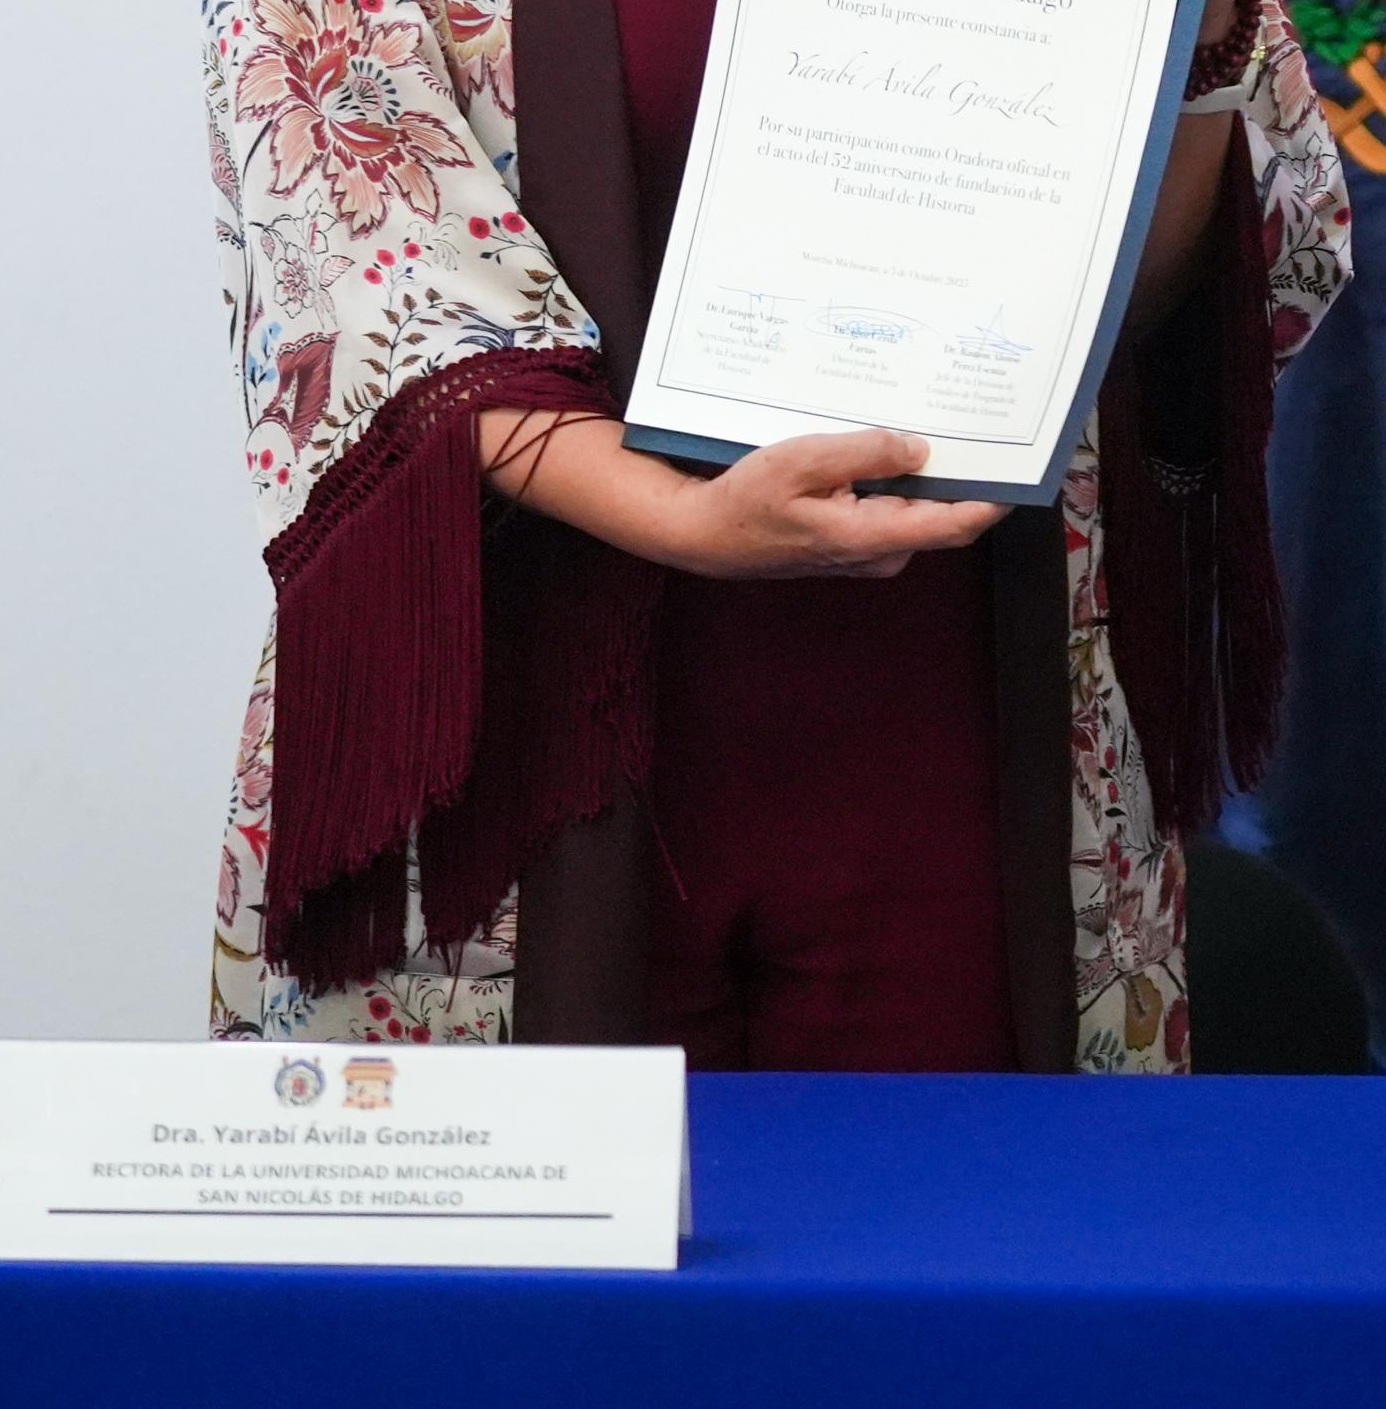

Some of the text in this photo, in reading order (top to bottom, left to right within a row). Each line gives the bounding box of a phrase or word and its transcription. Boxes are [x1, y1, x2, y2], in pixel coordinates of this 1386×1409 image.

[881, 2, 893, 19] la
[895, 6, 959, 31] presente
[960, 19, 1038, 45] constancia
[787, 50, 869, 86] Yarabí
[758, 115, 1071, 181] Por su participación como Oradora oficial en
[757, 141, 1061, 205] el acto del 52 aniversario de fundación de la
[832, 177, 976, 216] Facultad de Historia
[153, 1118, 492, 1146] Dra. Yarabí Ávila González
[92, 1161, 568, 1181] RECTORA DE LA UNIVERSIDAD MICHOACANA DE
[198, 1185, 464, 1207] SAN NICOLÁS DE HIDALGO
